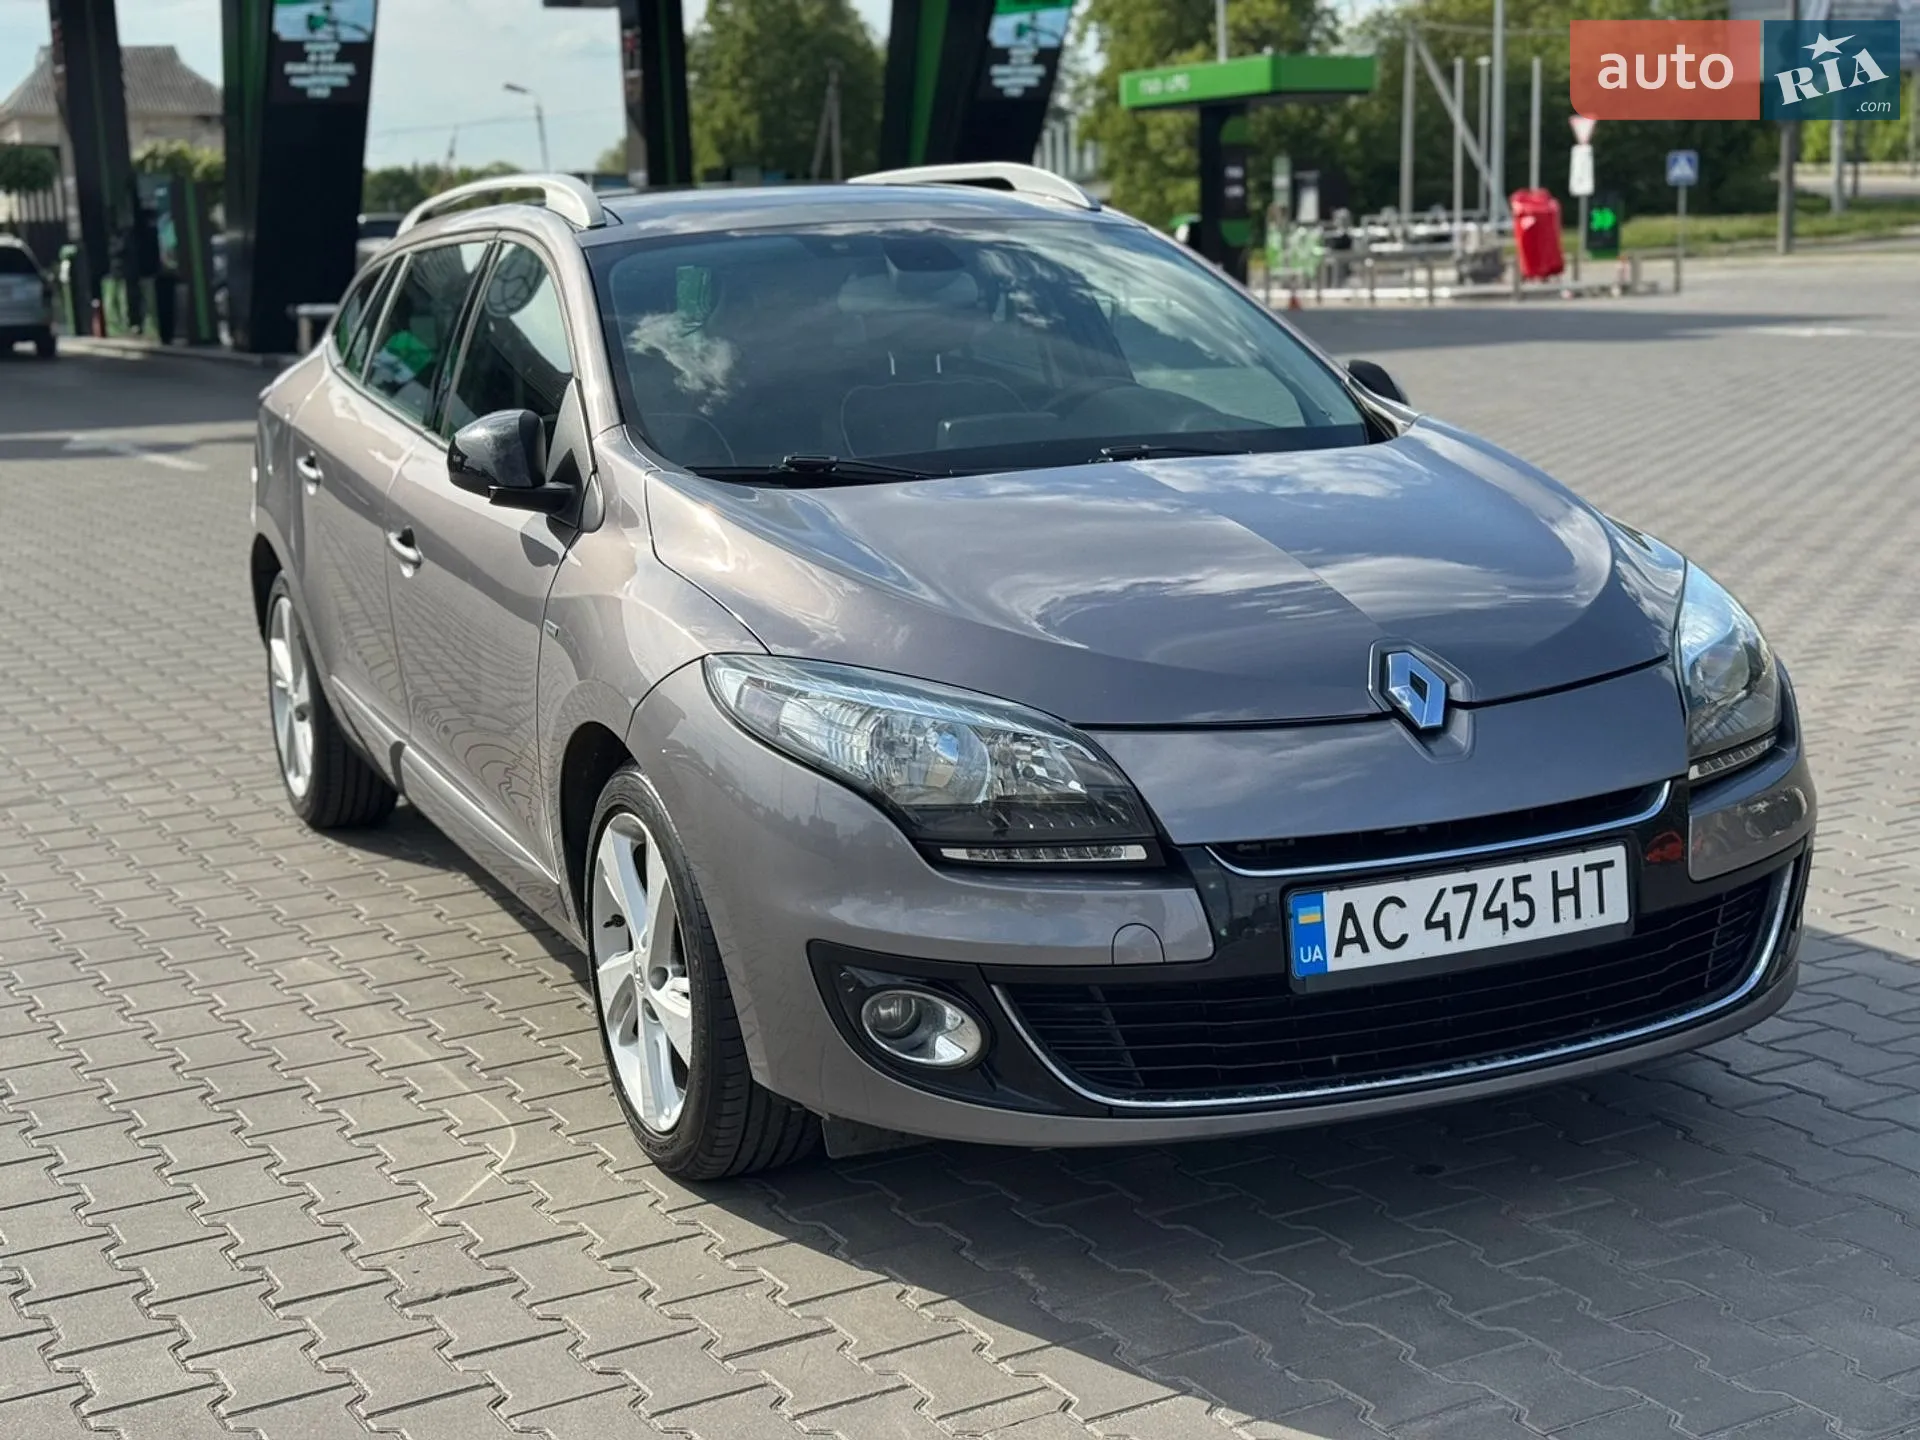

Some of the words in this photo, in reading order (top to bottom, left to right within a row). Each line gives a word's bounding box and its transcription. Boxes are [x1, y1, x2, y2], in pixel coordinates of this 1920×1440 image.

[1334, 896, 1409, 958] AC
[1424, 874, 1536, 942] 4745
[1551, 860, 1615, 924] HT
[1300, 944, 1324, 963] UA
